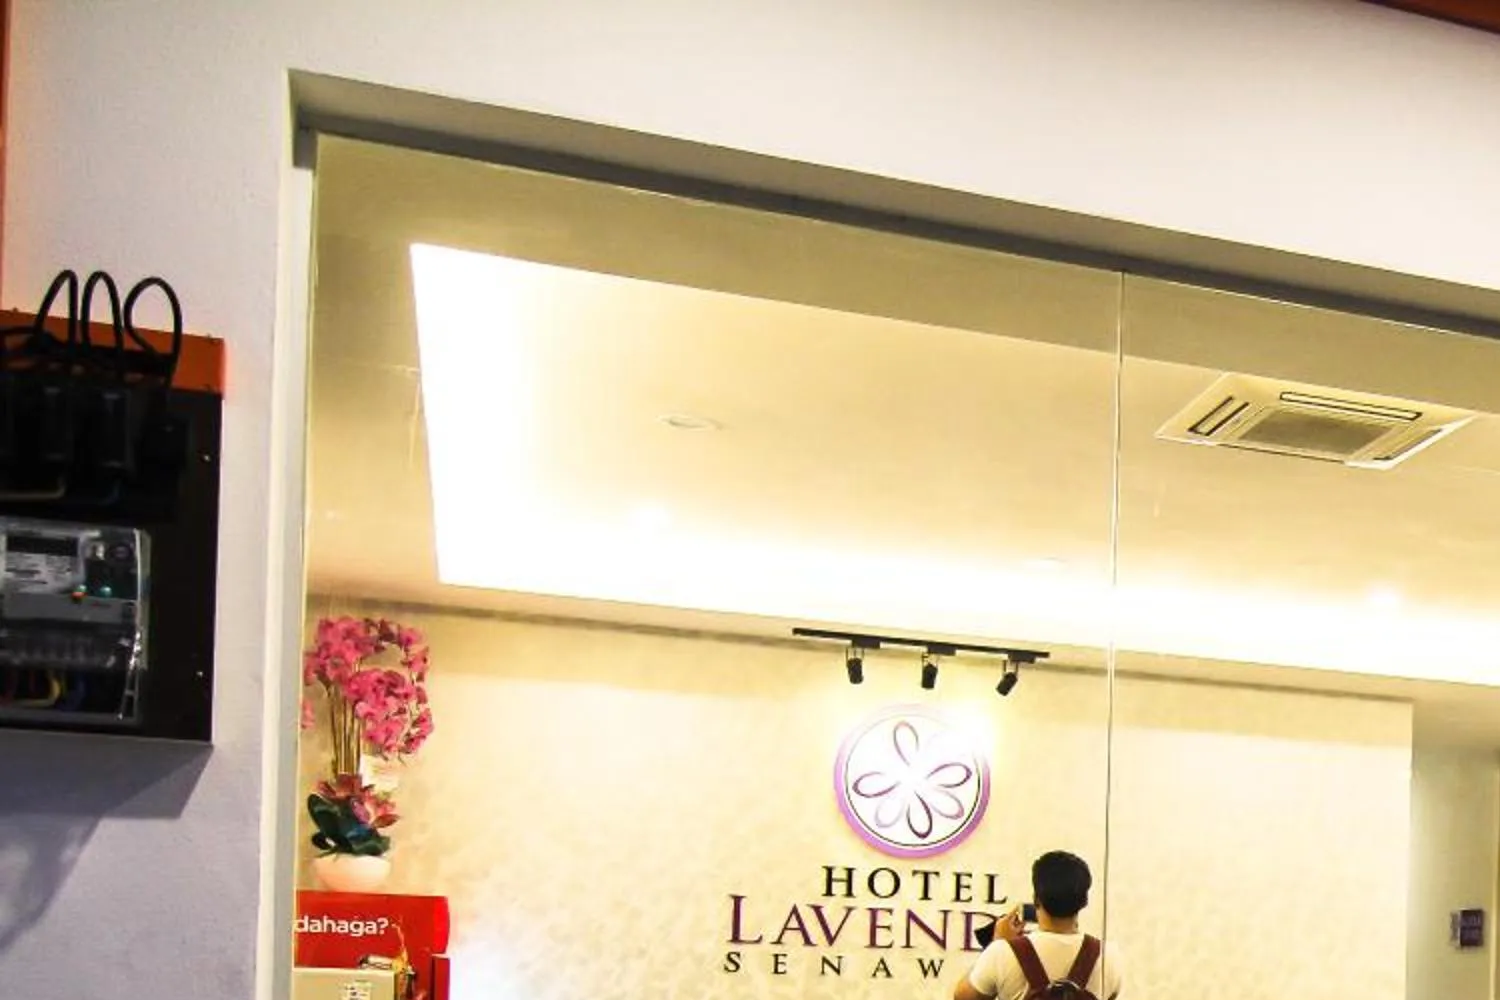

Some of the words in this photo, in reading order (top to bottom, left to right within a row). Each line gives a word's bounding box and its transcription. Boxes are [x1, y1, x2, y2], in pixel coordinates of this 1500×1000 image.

[821, 865, 1009, 905] HOTEL
[294, 914, 389, 937] dahaga?
[726, 893, 1008, 953] LAVEND
[723, 951, 945, 980] SENAW
